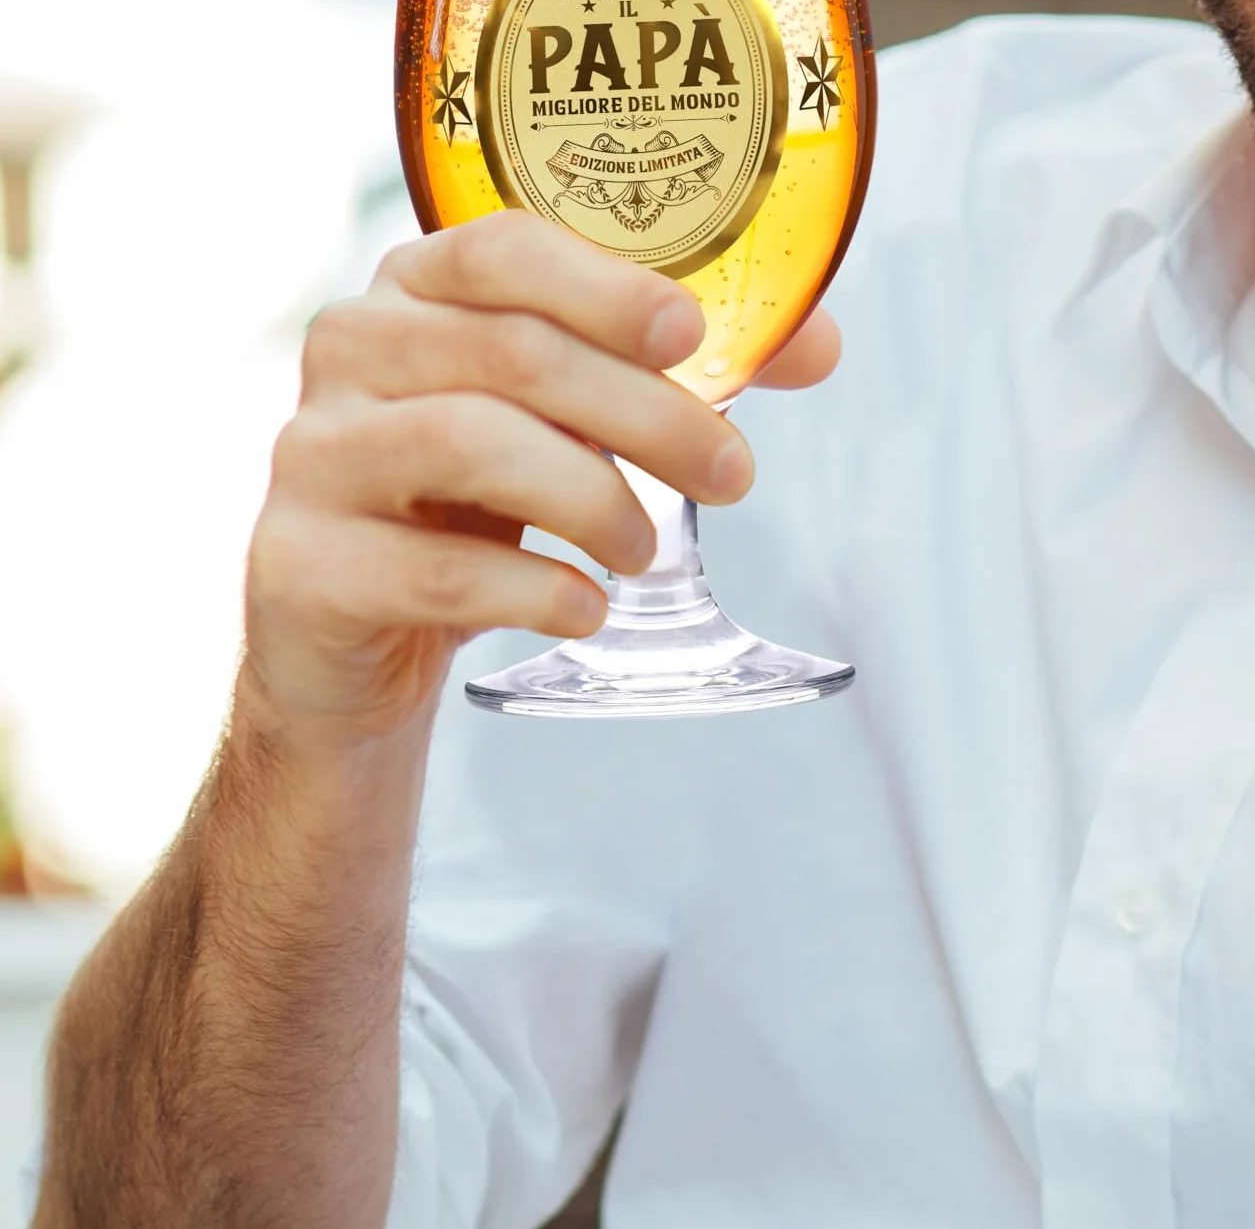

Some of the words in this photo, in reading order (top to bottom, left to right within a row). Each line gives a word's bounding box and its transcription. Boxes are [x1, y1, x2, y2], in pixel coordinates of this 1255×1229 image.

[619, 0, 638, 17] IL
[527, 3, 741, 94] PAPÀ
[531, 97, 622, 117] MIGLIORE
[628, 95, 665, 112] DEL
[671, 92, 740, 111] MONDO
[569, 153, 636, 174] EDIZIONE
[639, 146, 704, 173] LIMITATA
